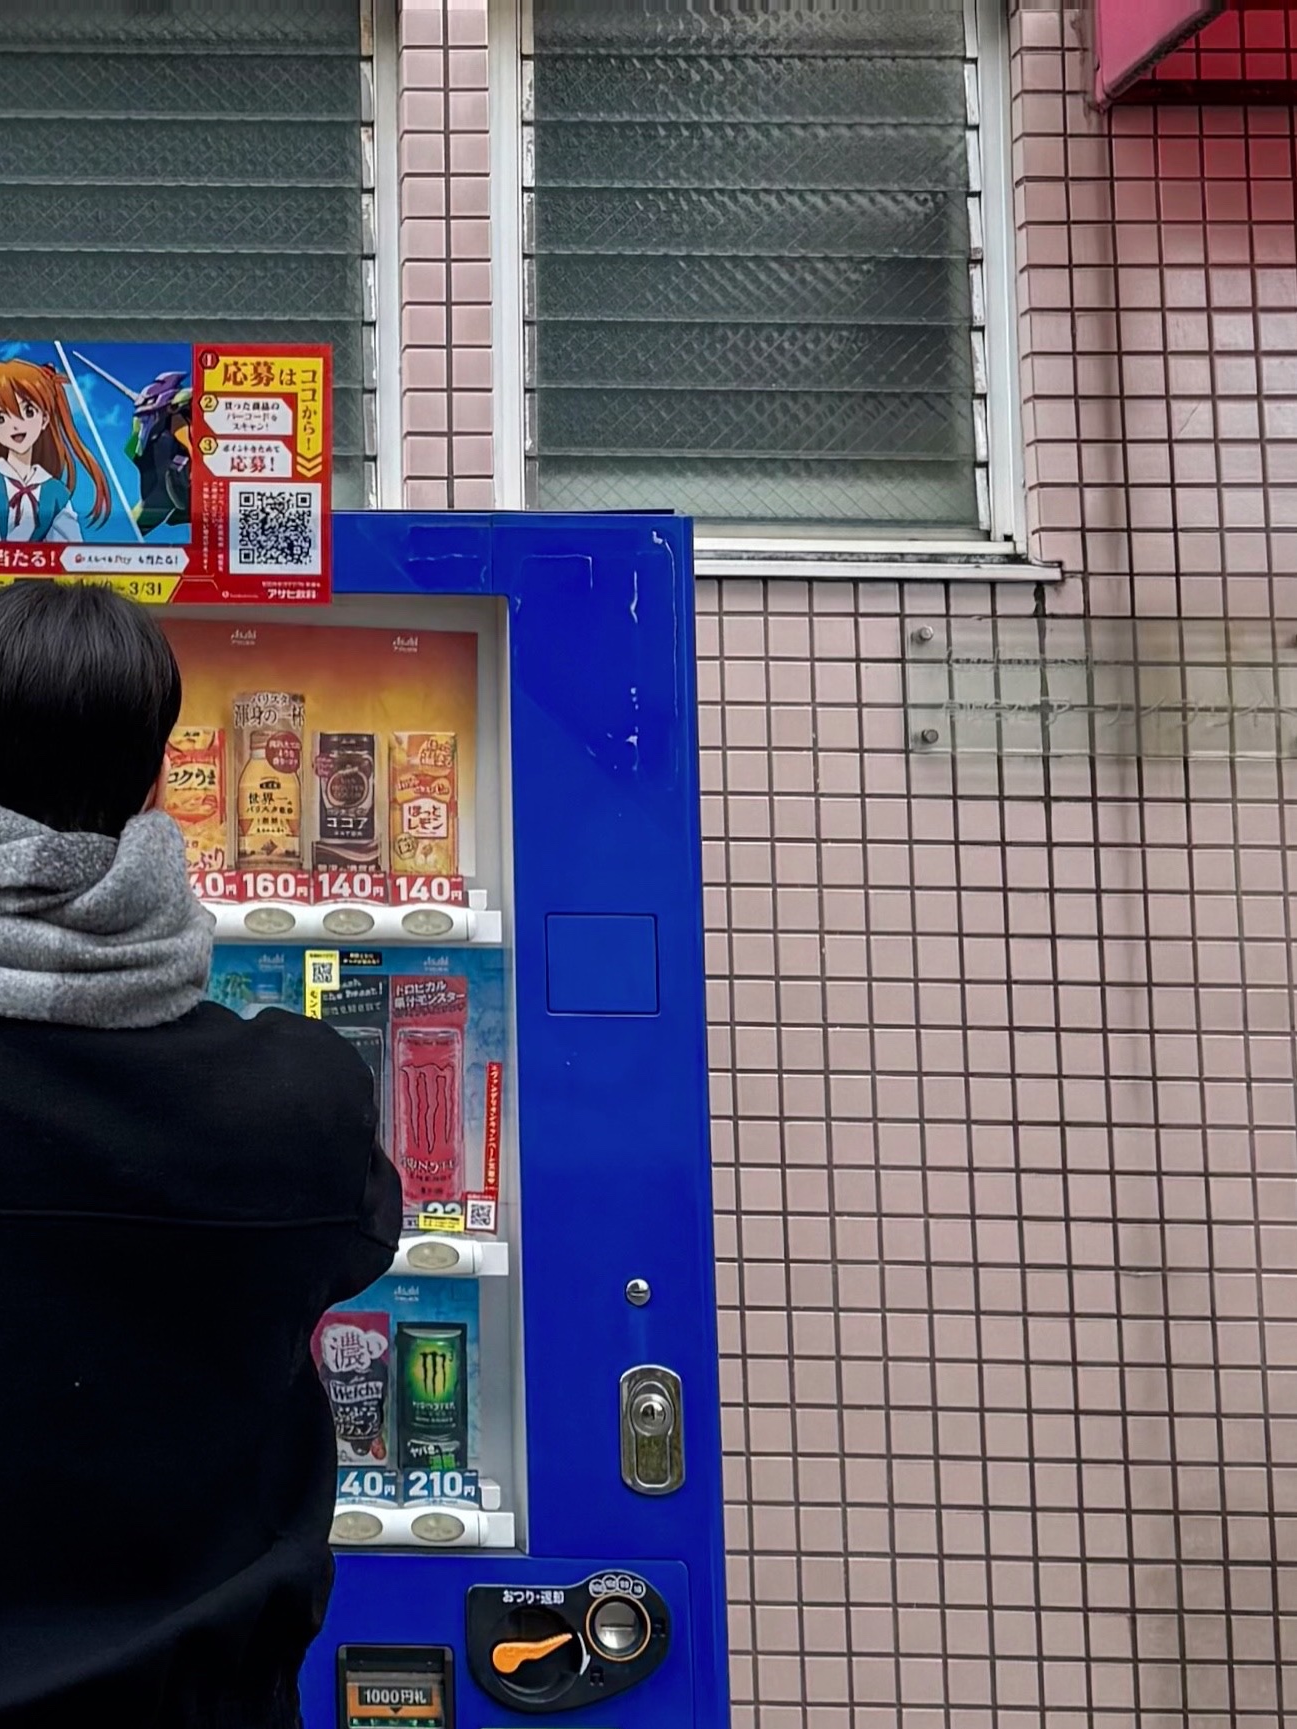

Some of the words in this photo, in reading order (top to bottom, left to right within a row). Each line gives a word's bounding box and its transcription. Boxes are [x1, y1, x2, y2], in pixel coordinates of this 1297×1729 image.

[222, 361, 297, 386] 応募は
[204, 397, 213, 409] 2
[203, 439, 212, 451] 3
[230, 456, 274, 473] 応募!
[408, 805, 442, 818] ほっと
[326, 817, 369, 830] ココア
[407, 818, 444, 831] レモン
[191, 871, 237, 898] 40円
[243, 872, 308, 899] 160円
[317, 874, 384, 899] 140円
[395, 876, 463, 902] 140円
[340, 1471, 396, 1497] 40円
[408, 1471, 475, 1497] 210円
[502, 1589, 565, 1606] おつり・返却
[365, 1688, 427, 1704] 1000円札
